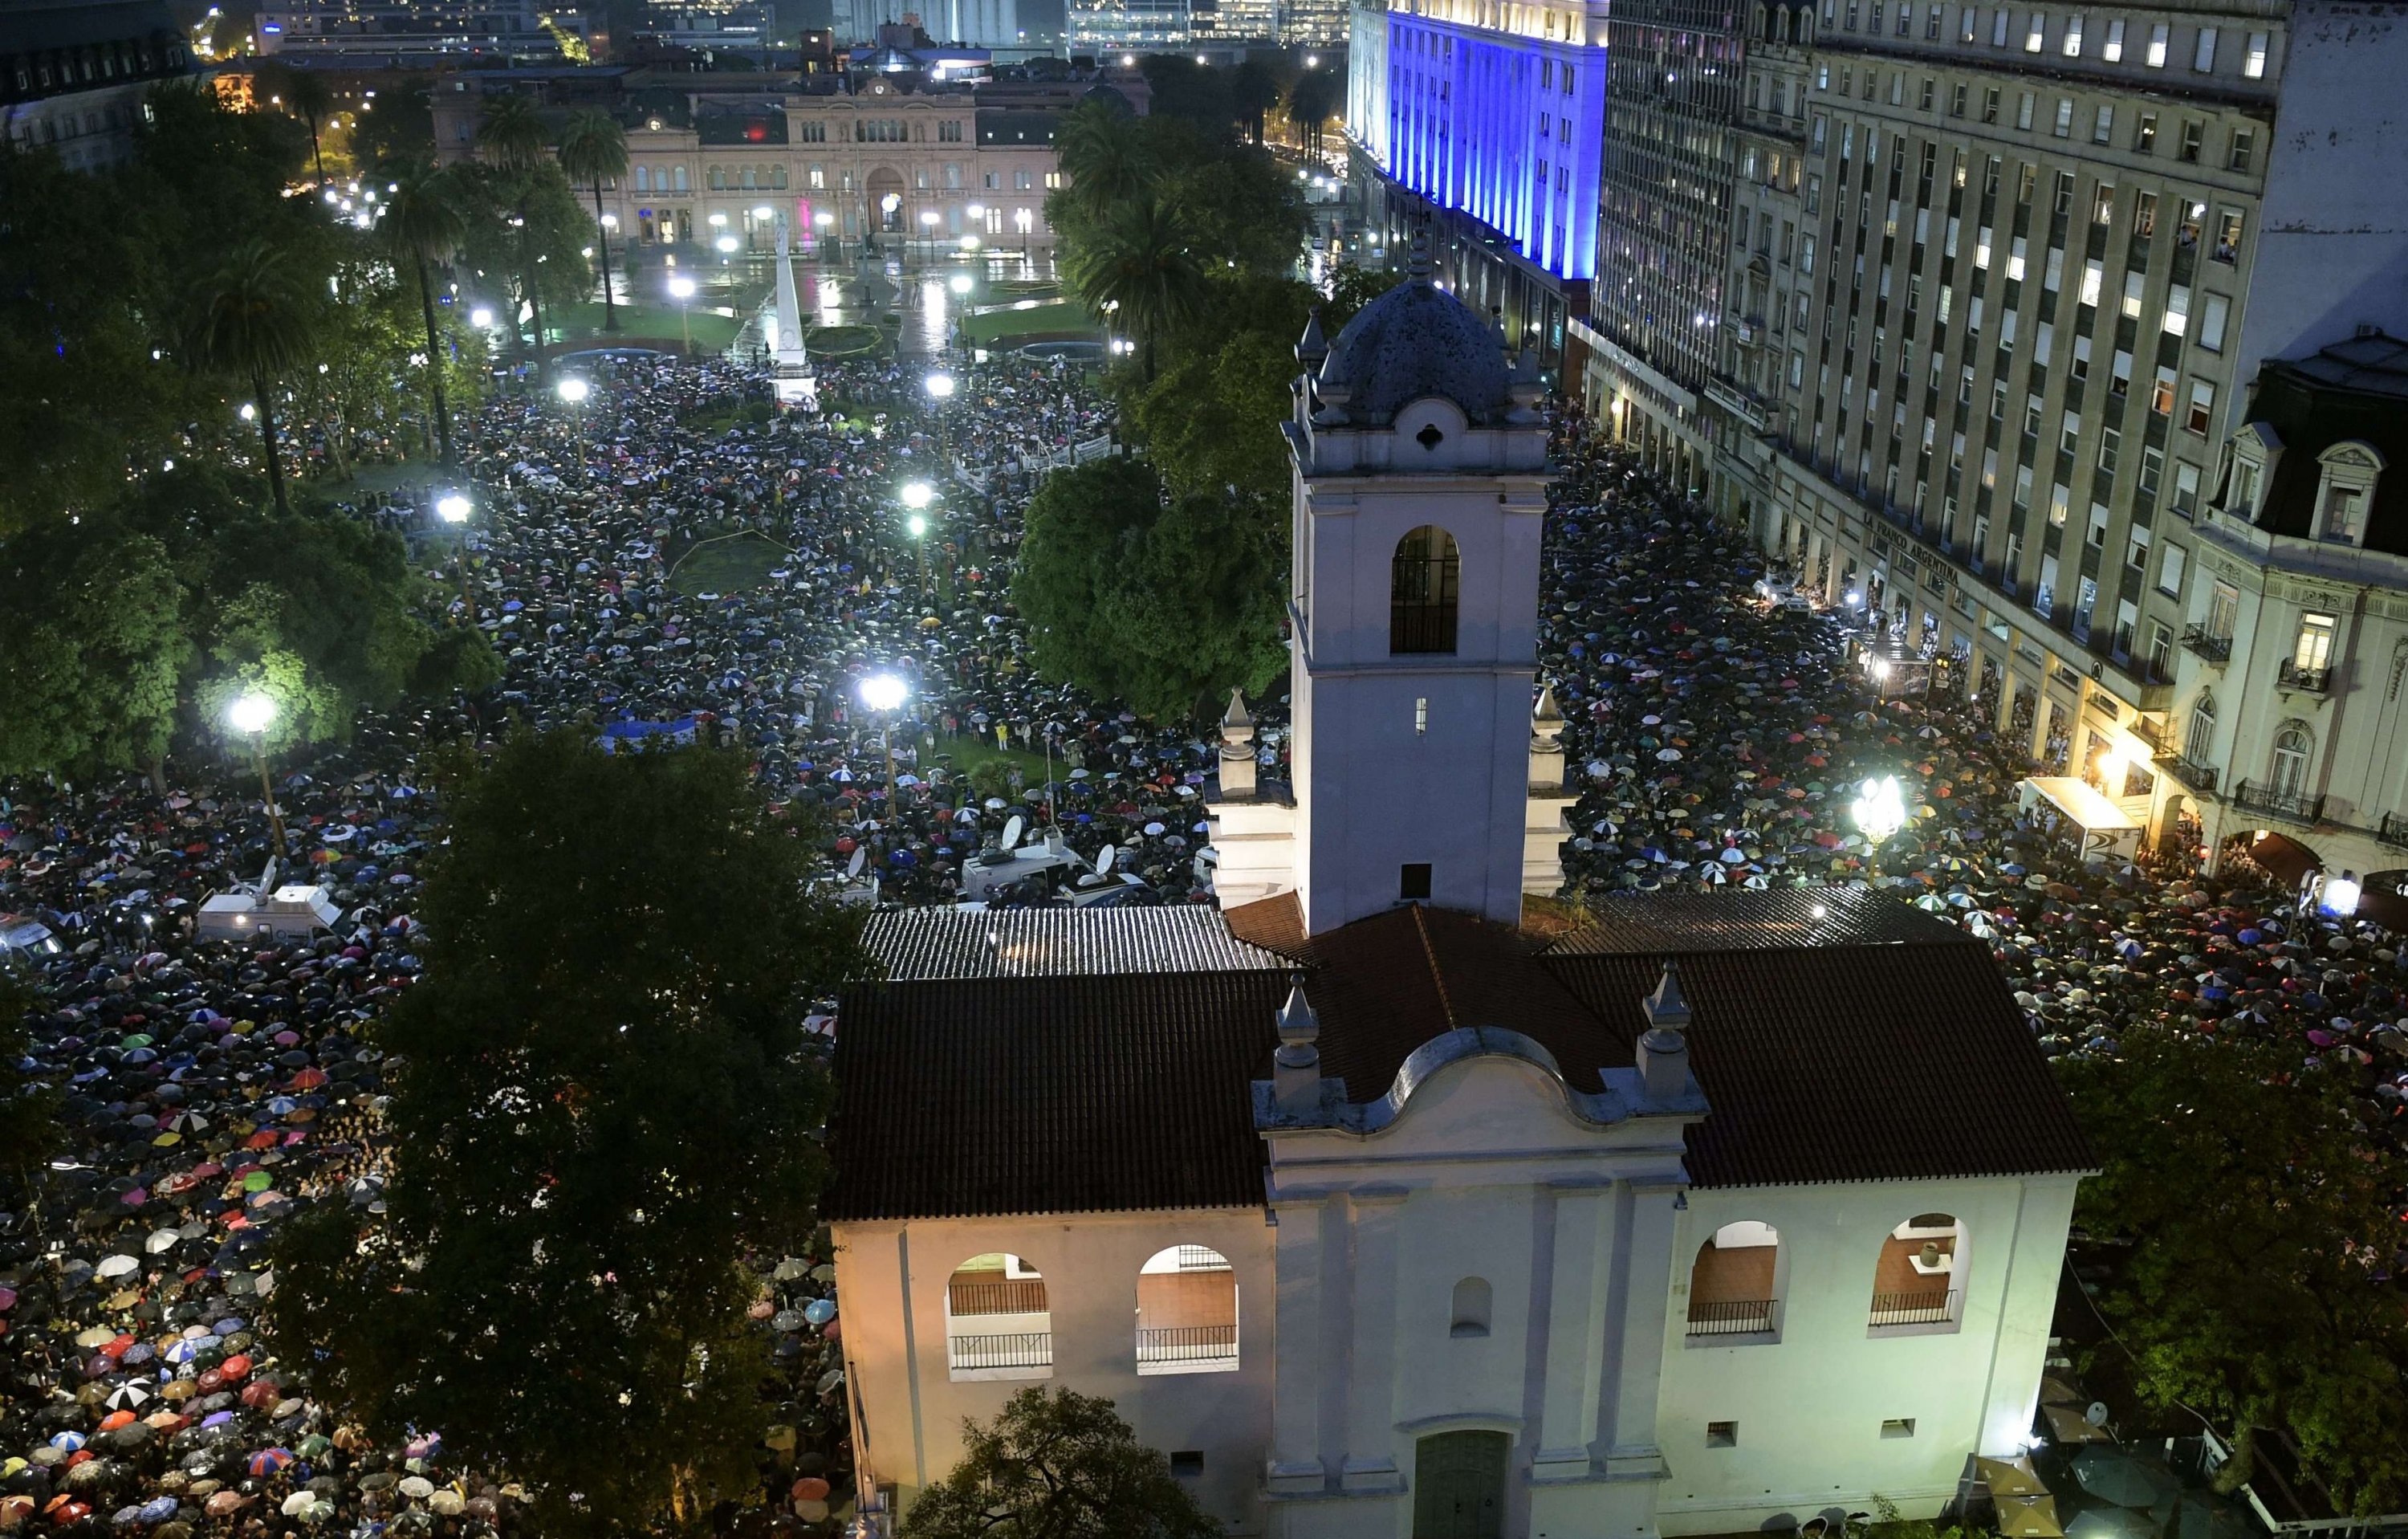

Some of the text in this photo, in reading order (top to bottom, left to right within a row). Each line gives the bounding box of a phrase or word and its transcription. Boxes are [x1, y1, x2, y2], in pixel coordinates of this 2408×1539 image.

[1863, 511, 1959, 585] LA FRANCO ARGENTINA
